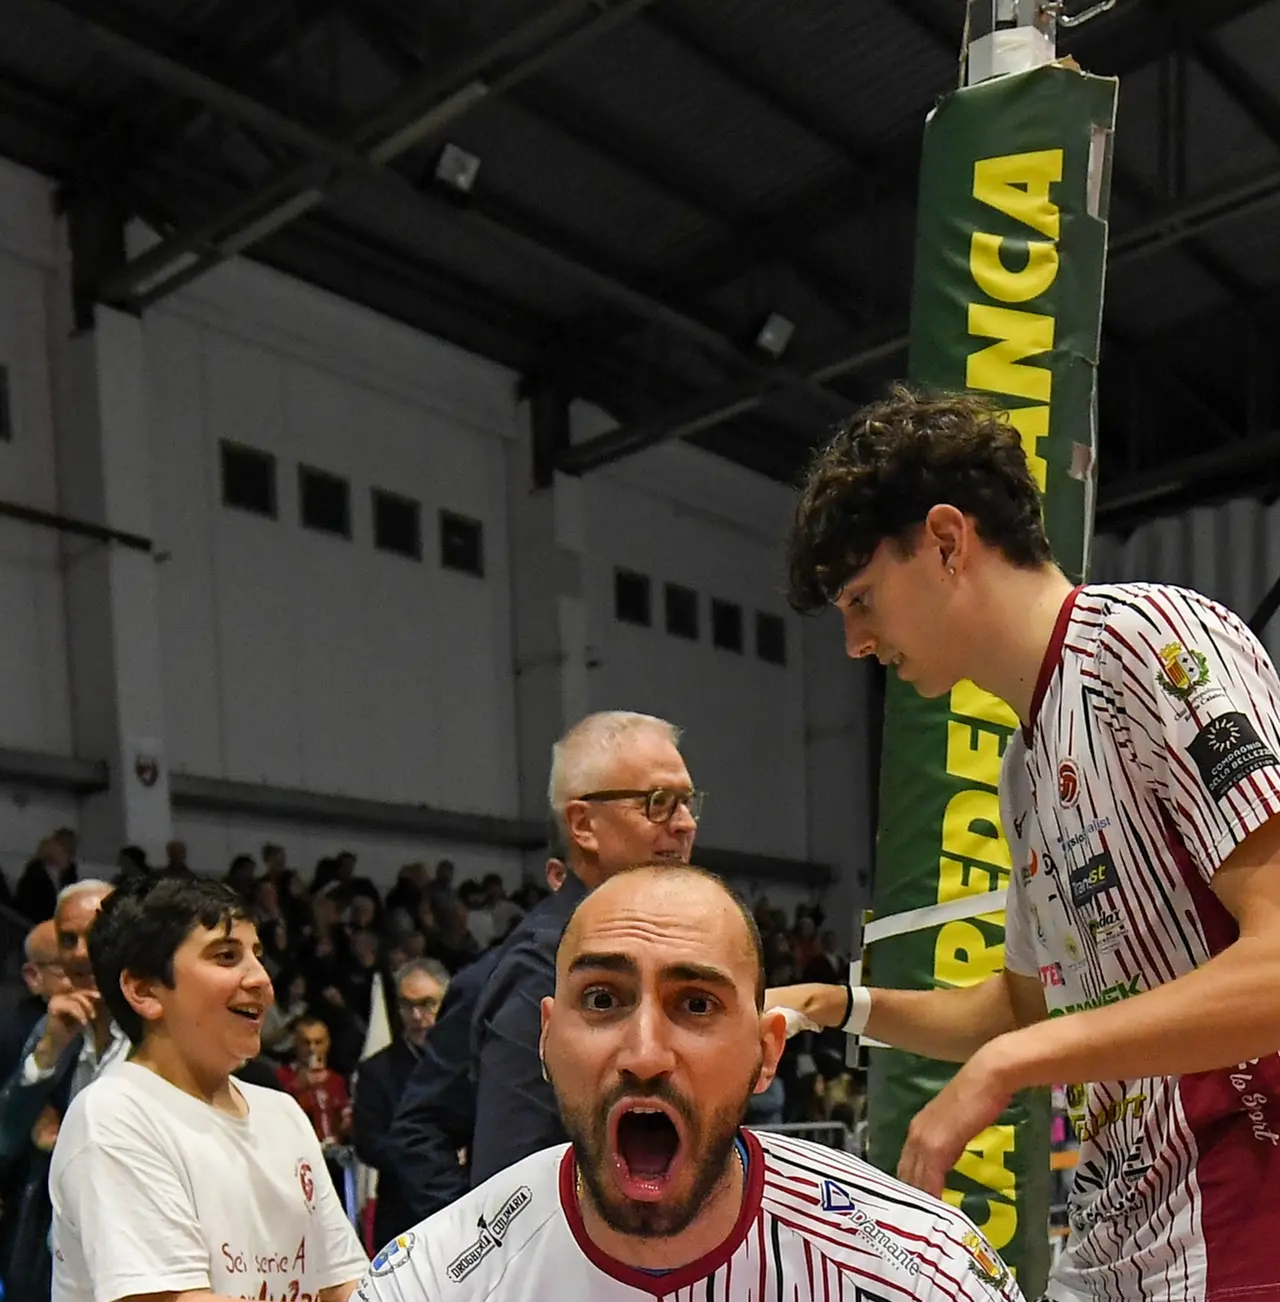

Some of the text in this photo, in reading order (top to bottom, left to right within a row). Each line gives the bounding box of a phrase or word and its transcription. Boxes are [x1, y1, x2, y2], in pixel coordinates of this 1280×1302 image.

[492, 1191, 529, 1236] CULINARIA
[221, 1242, 248, 1274] Sei
[292, 1235, 306, 1275] A
